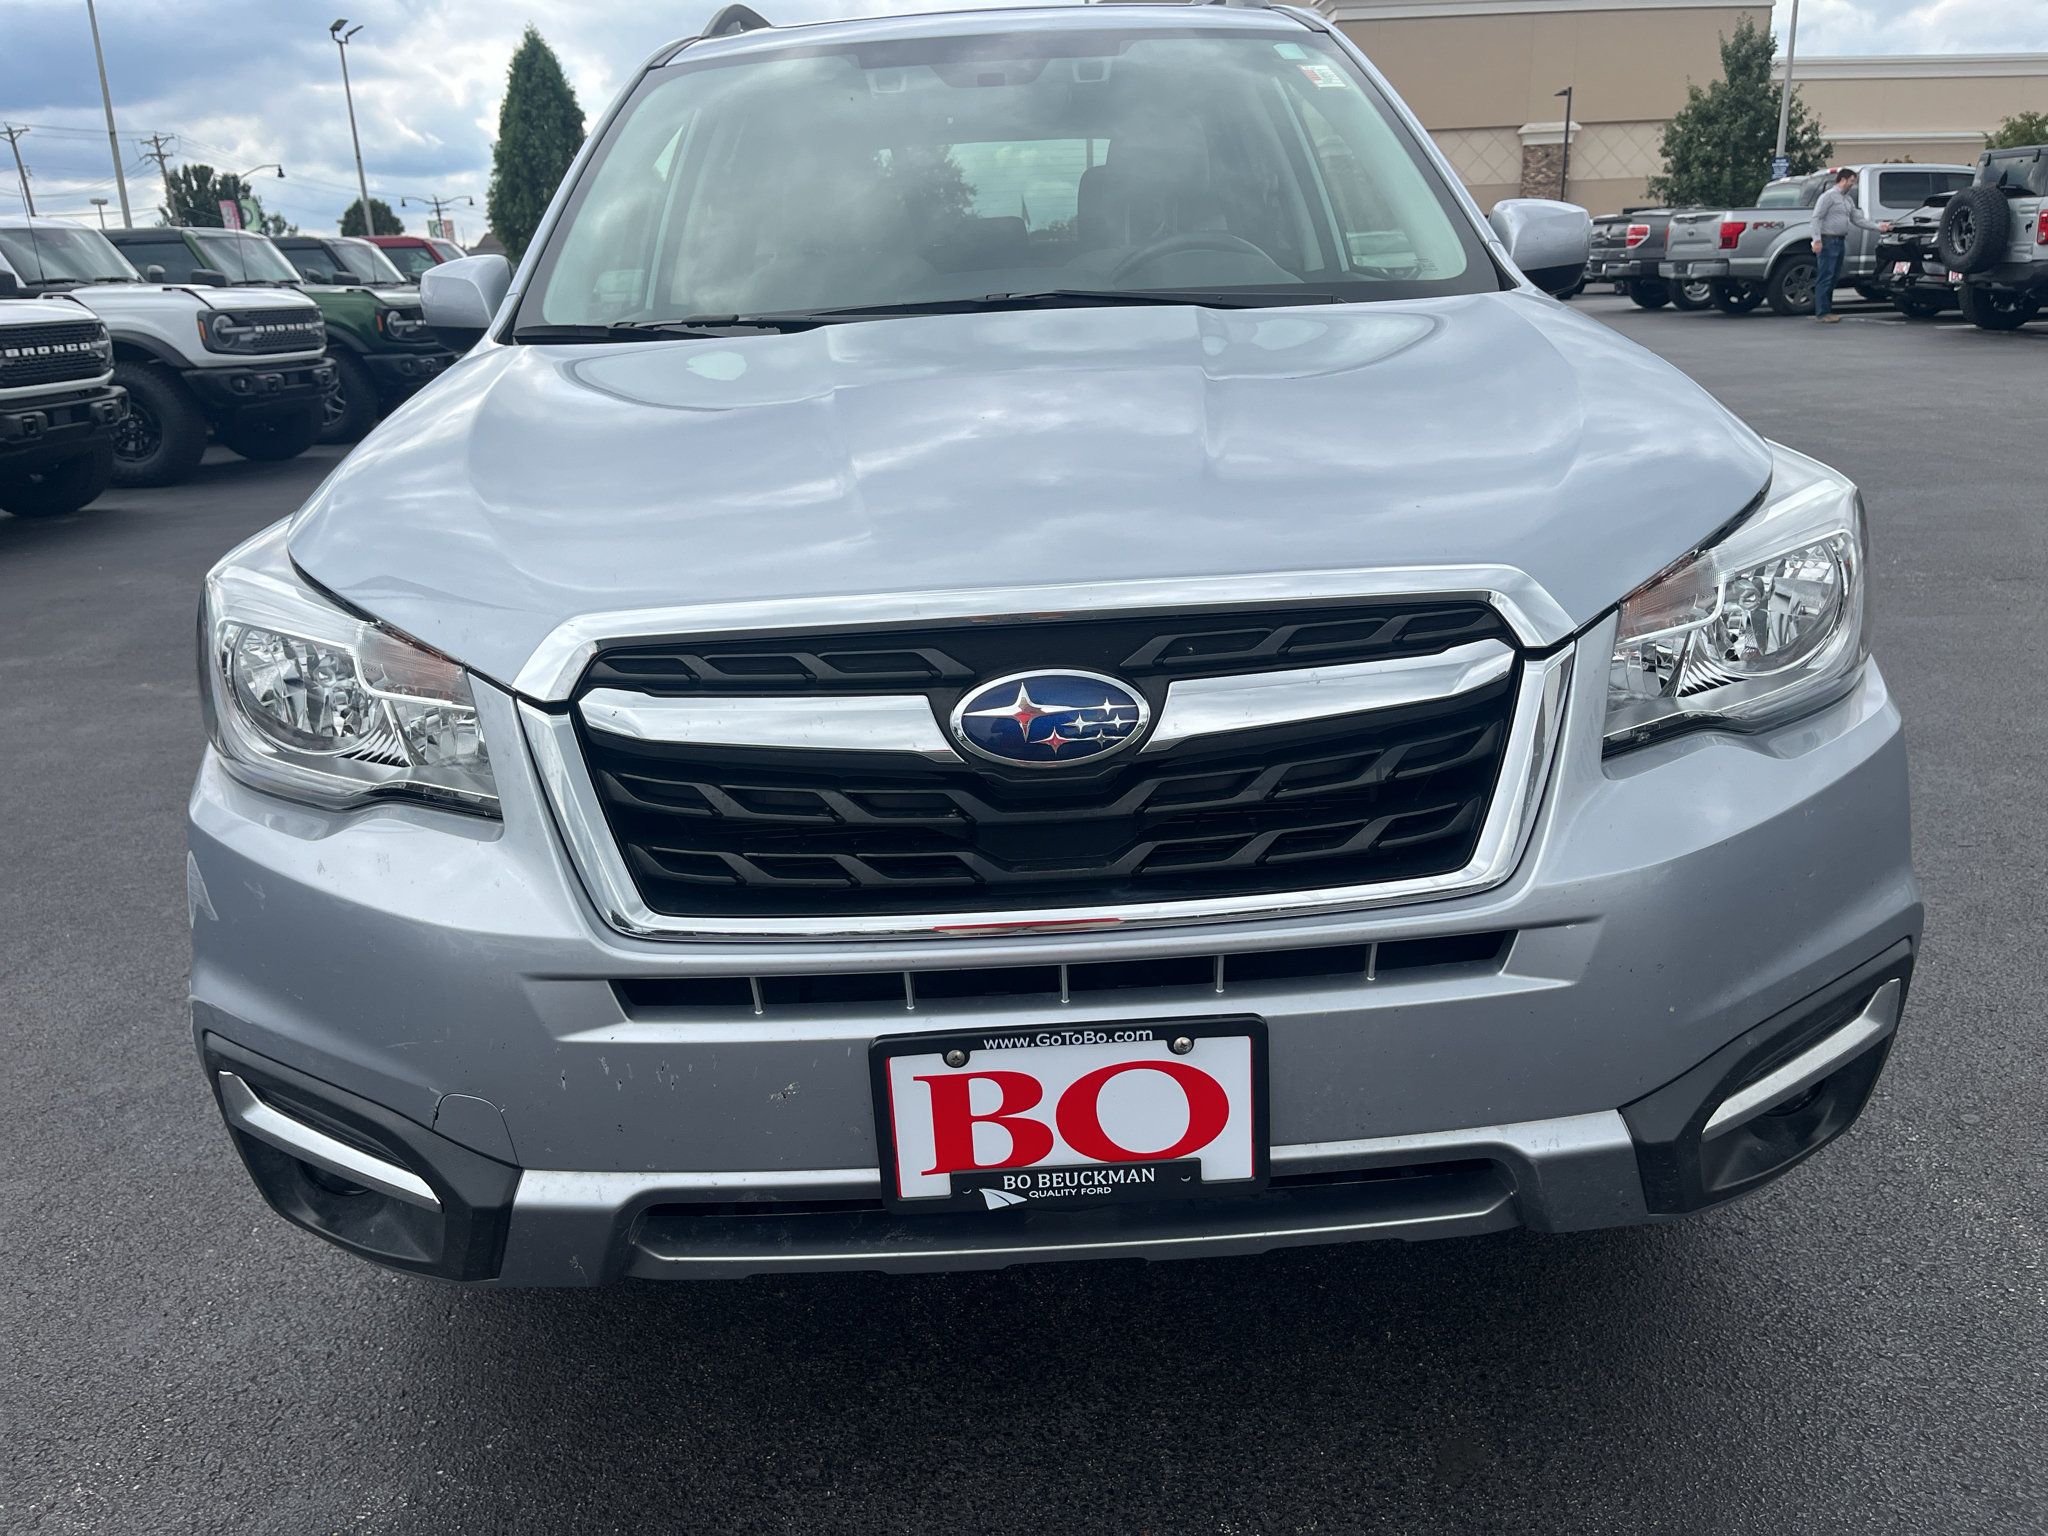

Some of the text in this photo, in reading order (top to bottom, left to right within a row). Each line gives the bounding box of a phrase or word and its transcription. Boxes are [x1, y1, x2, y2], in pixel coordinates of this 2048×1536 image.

[983, 1029, 1153, 1050] www.GoToBo.com
[912, 1060, 1230, 1177] BO
[1003, 1167, 1155, 1190] BO BEUCKMAN
[1028, 1186, 1112, 1199] QUALITY FORD
